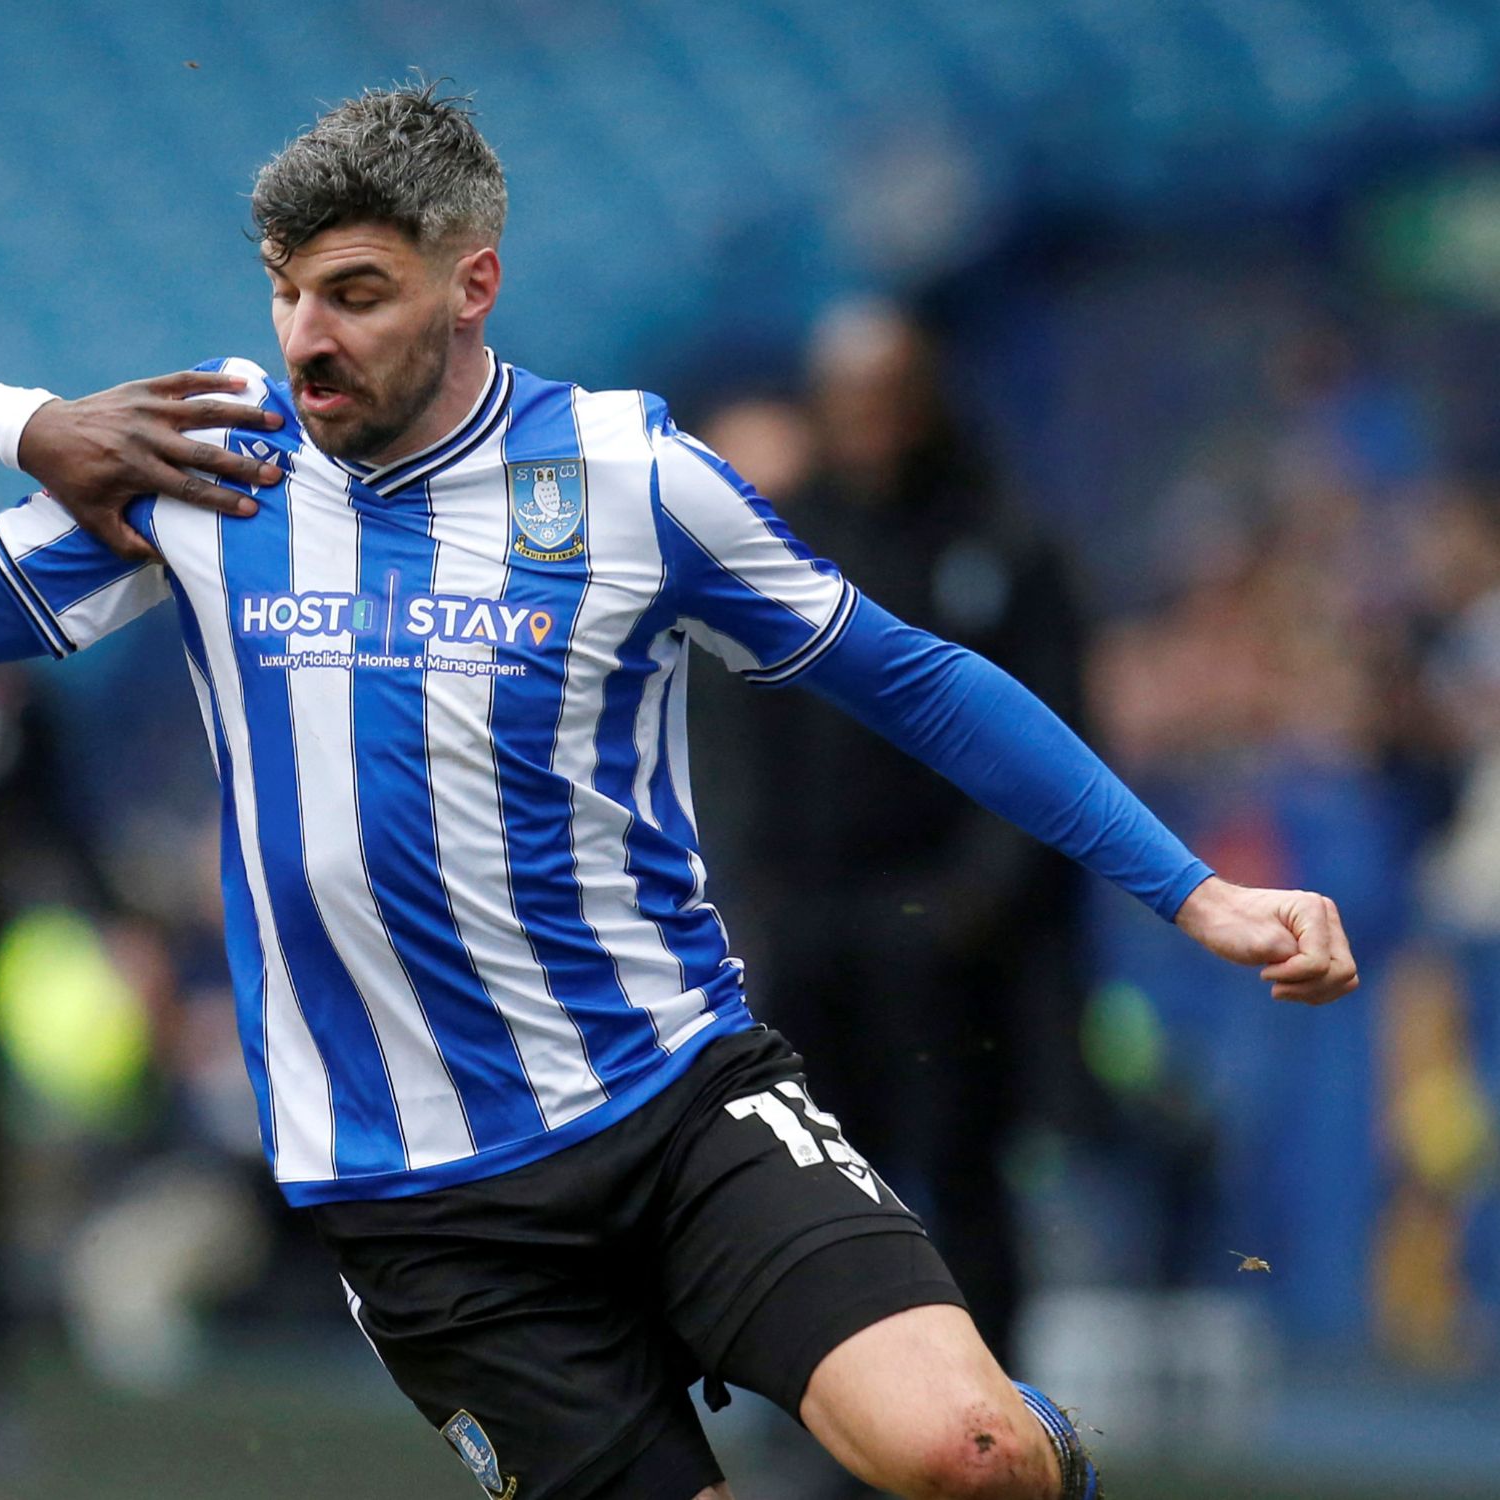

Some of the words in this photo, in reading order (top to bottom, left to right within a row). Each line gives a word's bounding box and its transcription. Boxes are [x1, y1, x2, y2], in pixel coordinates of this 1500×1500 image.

[243, 596, 349, 632] HOST
[406, 597, 531, 643] STAY
[259, 653, 301, 669] Luxury
[302, 651, 356, 669] Holiday
[358, 653, 410, 668] Homes
[414, 655, 424, 669] &
[427, 656, 527, 677] Management
